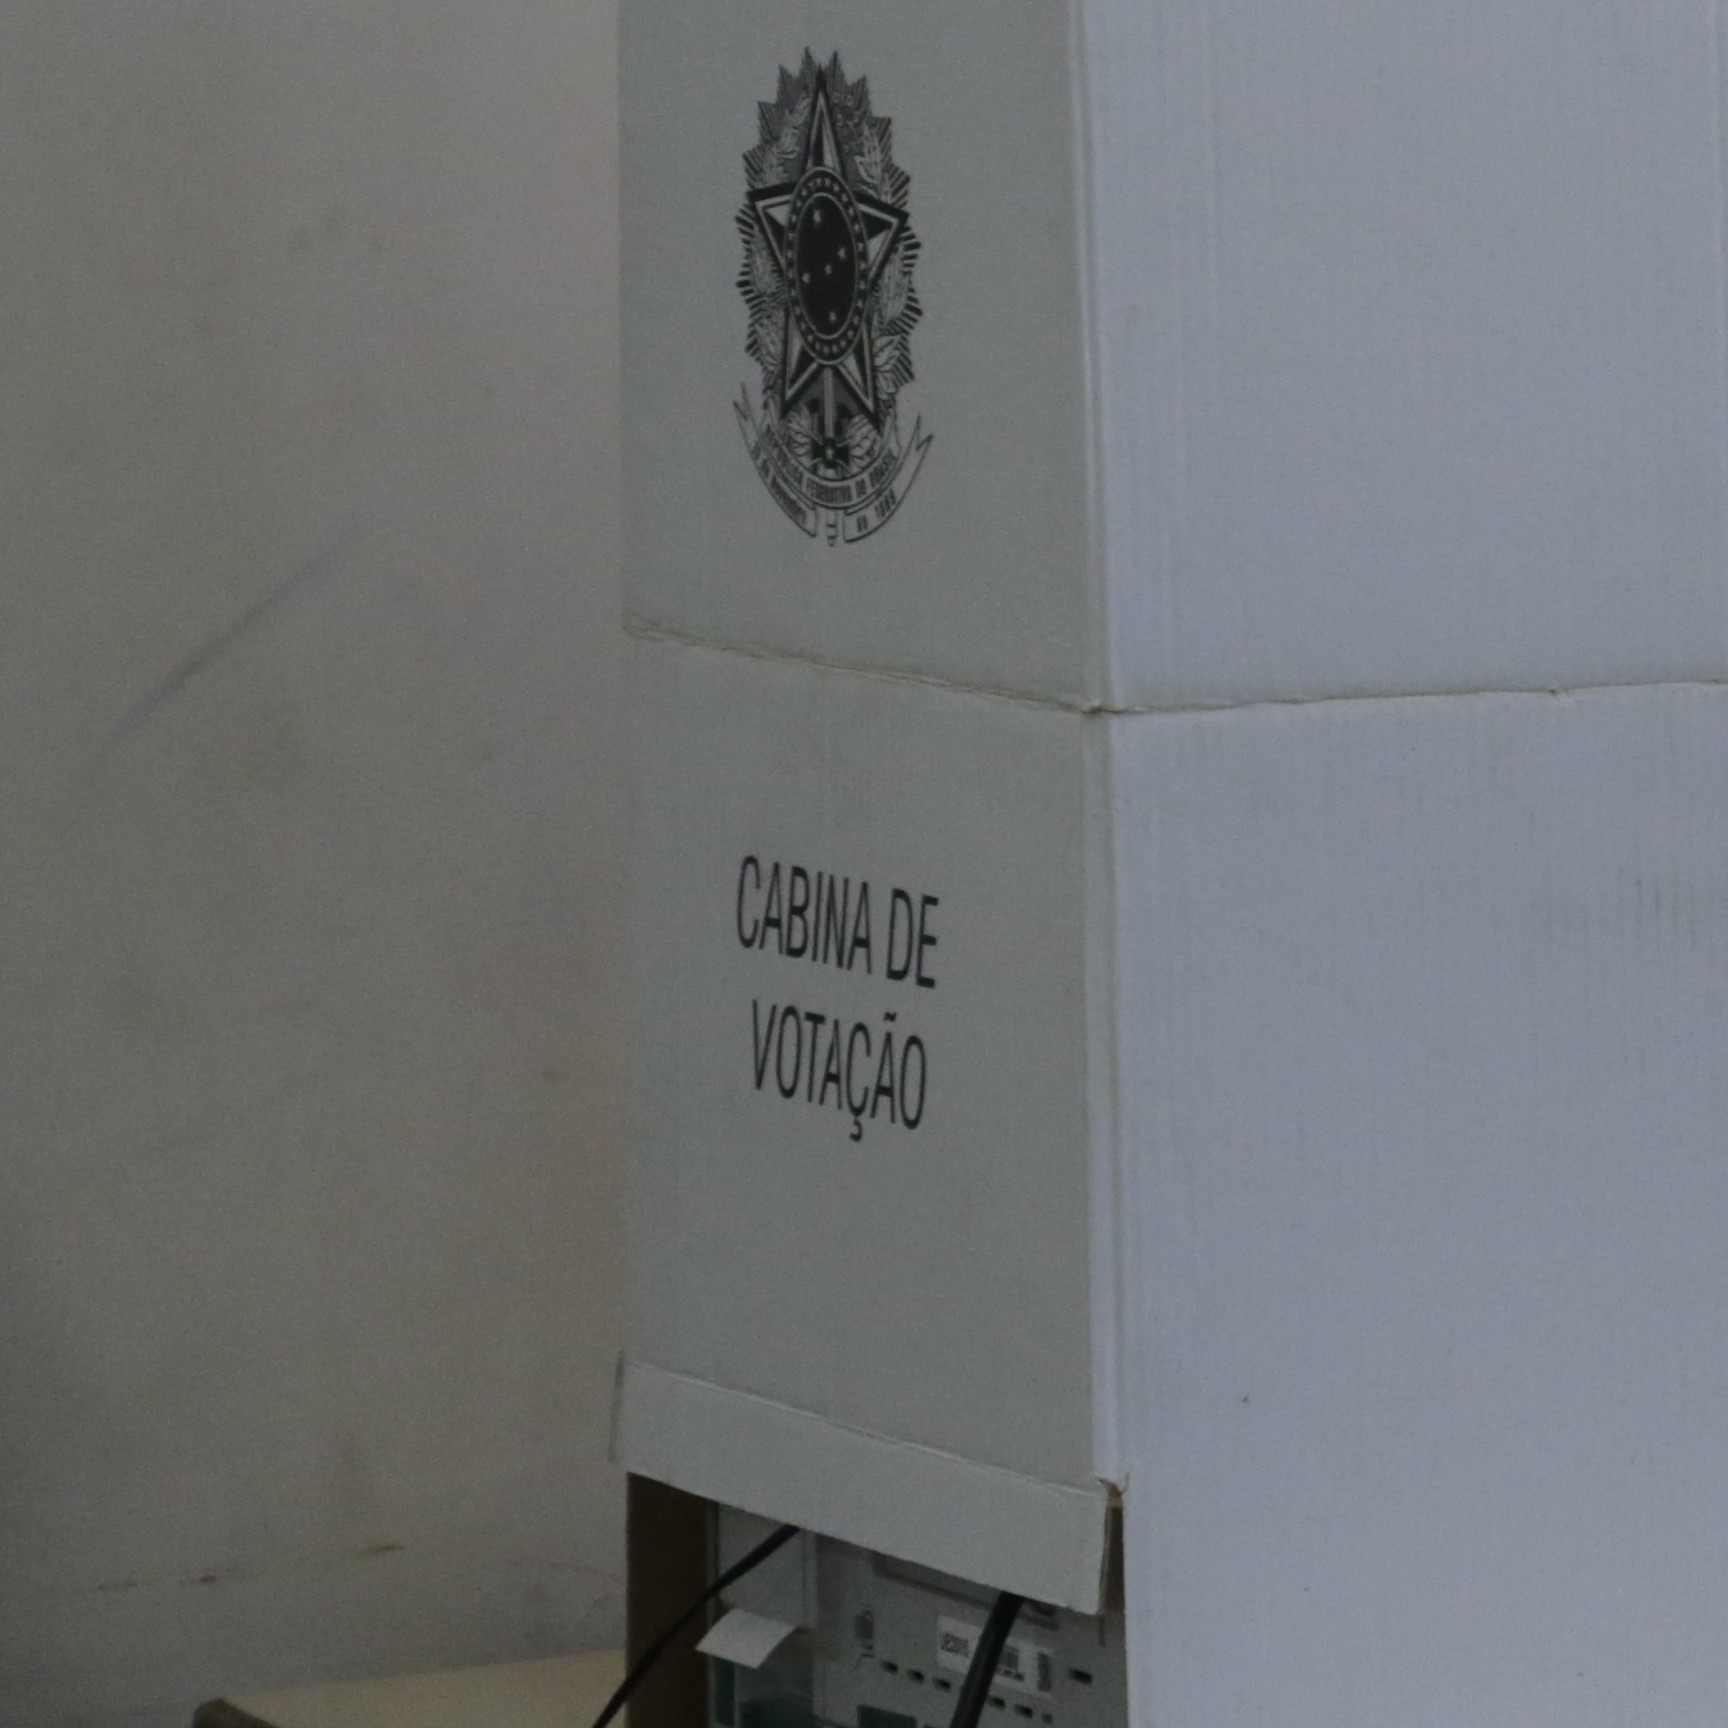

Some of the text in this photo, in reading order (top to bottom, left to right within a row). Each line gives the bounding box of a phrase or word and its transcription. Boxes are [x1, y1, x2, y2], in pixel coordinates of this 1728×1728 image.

[737, 855, 939, 988] CABINA DE
[752, 999, 926, 1141] VOTAÇÃO
